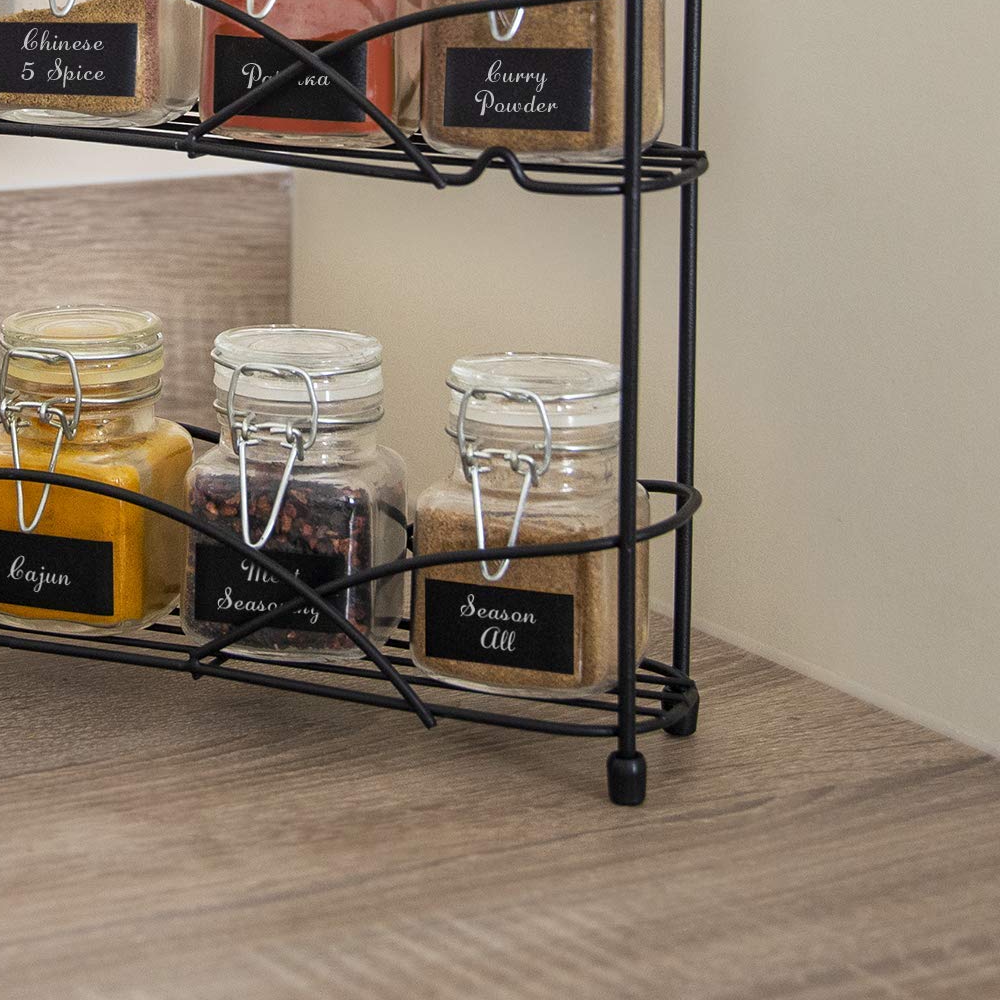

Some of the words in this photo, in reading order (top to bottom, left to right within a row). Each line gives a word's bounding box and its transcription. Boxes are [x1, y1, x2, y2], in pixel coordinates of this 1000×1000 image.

[21, 28, 105, 51] Chinese
[21, 62, 35, 81] 5
[48, 57, 106, 89] Spice
[242, 62, 331, 89] Paka
[484, 60, 548, 93] Curry
[475, 89, 559, 116] Powder
[7, 556, 71, 593] Cajun
[460, 593, 535, 624] Season
[481, 626, 516, 652] All
